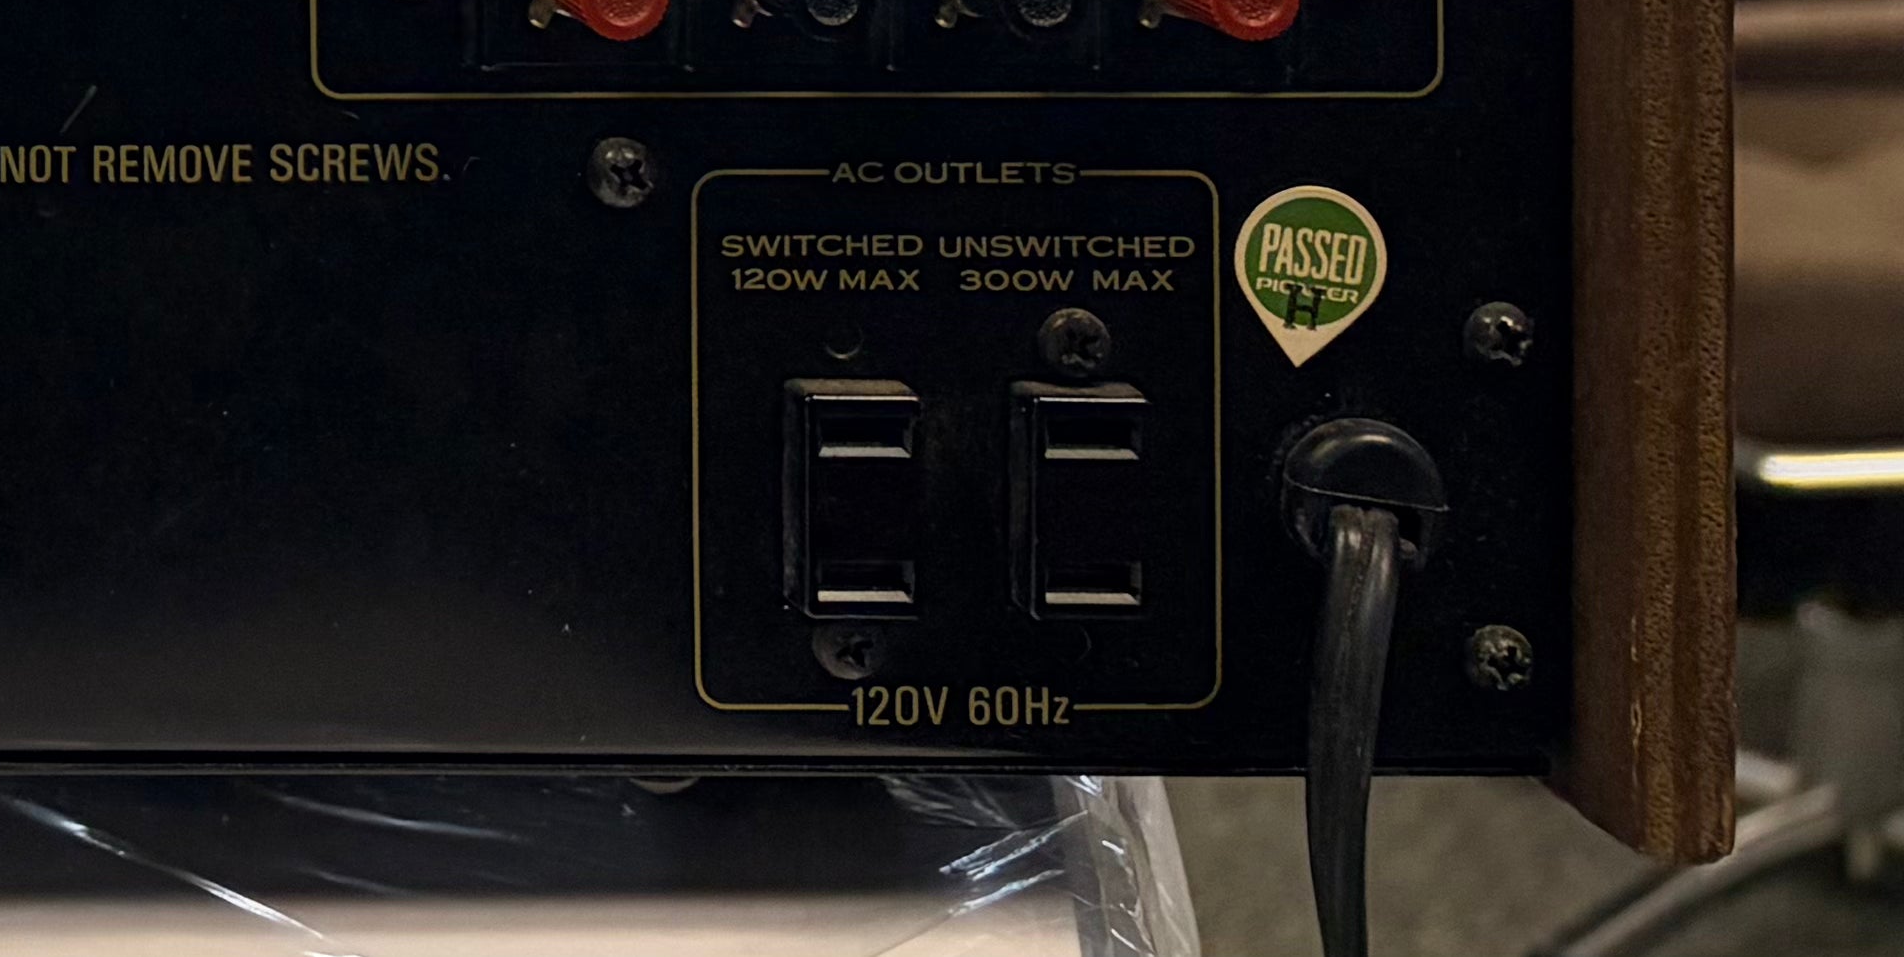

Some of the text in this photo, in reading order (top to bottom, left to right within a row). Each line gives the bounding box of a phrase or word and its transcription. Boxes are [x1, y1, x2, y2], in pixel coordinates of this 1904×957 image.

[0, 144, 77, 184] NOT
[93, 143, 252, 184] REMOVE
[269, 143, 450, 183] SCREWS.
[831, 161, 1075, 184] AC OUTLETS
[721, 234, 1196, 258] SWITCHED UNSWITCHED
[1259, 223, 1367, 285] PASSED
[731, 267, 1174, 292] 120W MAX 300W MAX
[851, 685, 1070, 726] 120V 60Hz
